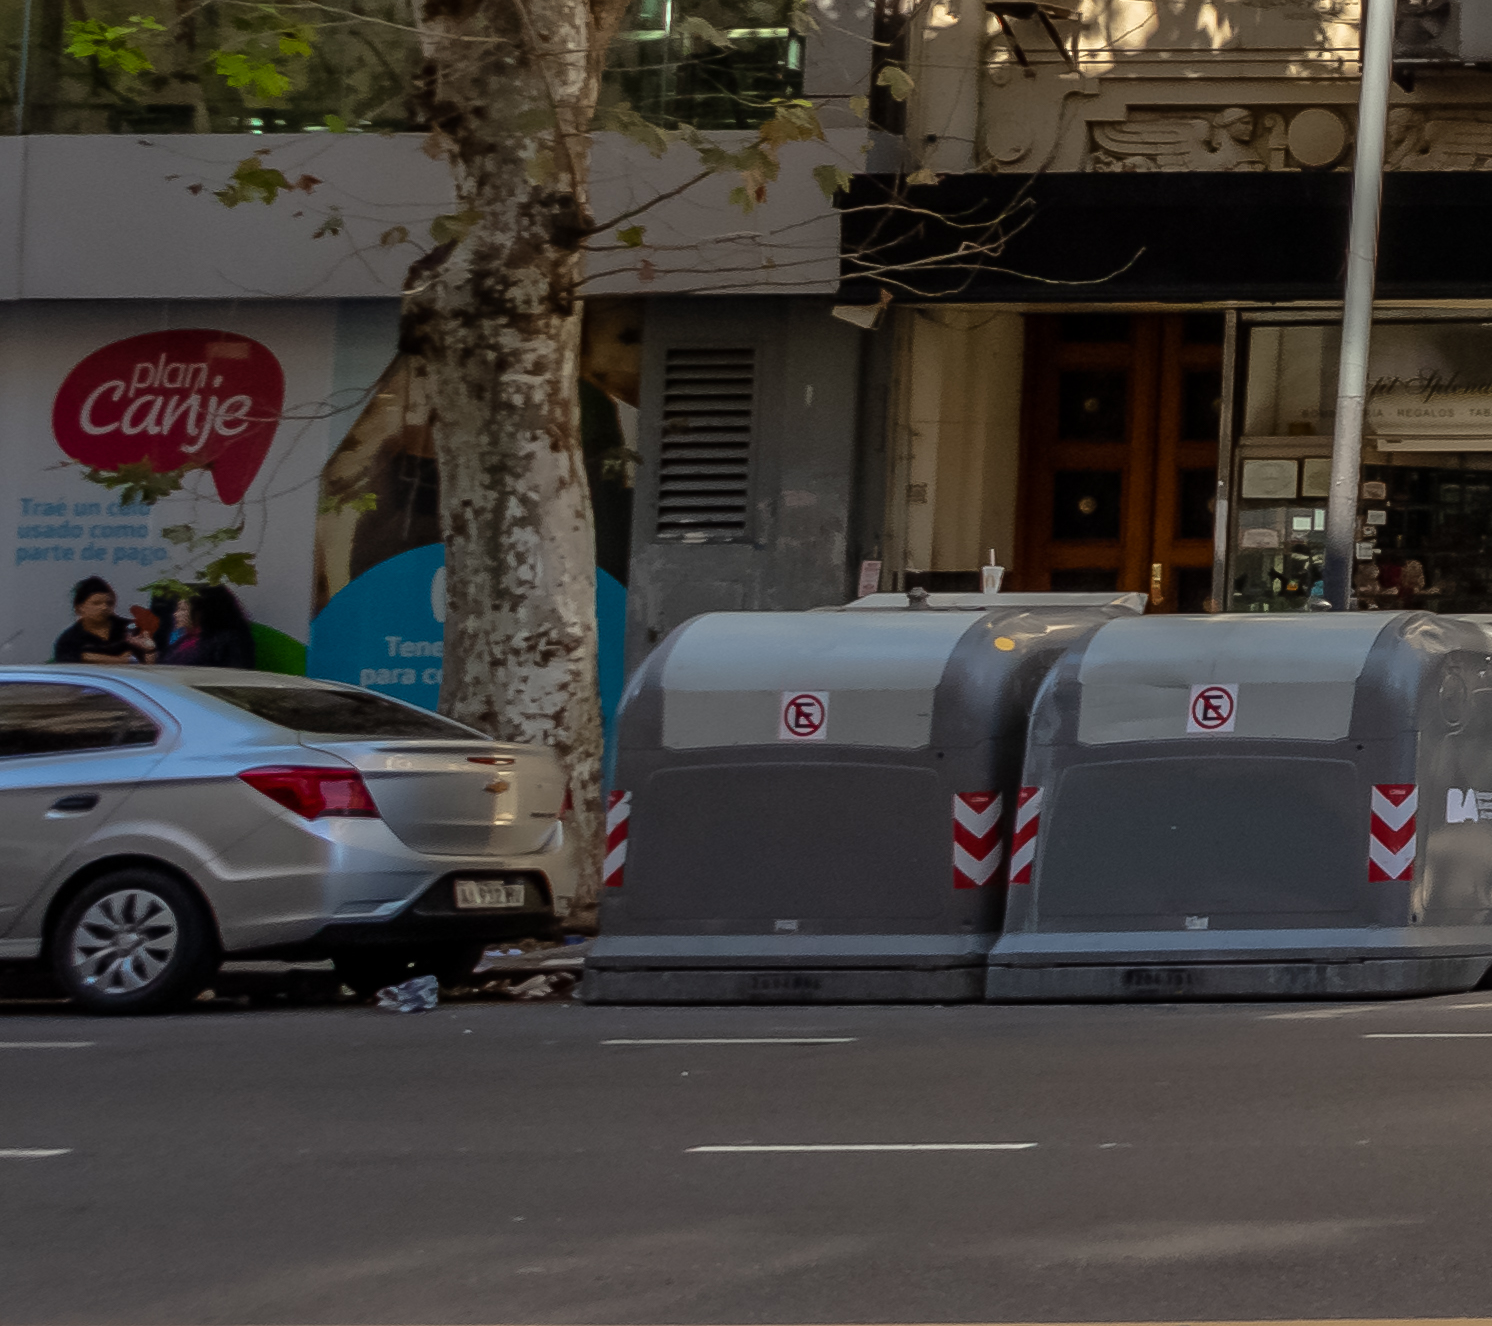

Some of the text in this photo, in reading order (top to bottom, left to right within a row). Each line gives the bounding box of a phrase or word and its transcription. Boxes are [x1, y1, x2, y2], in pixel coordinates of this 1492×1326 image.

[129, 352, 209, 397] plan
[78, 374, 253, 453] Canje
[1396, 408, 1455, 418] REGALOS
[88, 523, 148, 539] como
[80, 541, 107, 561] de
